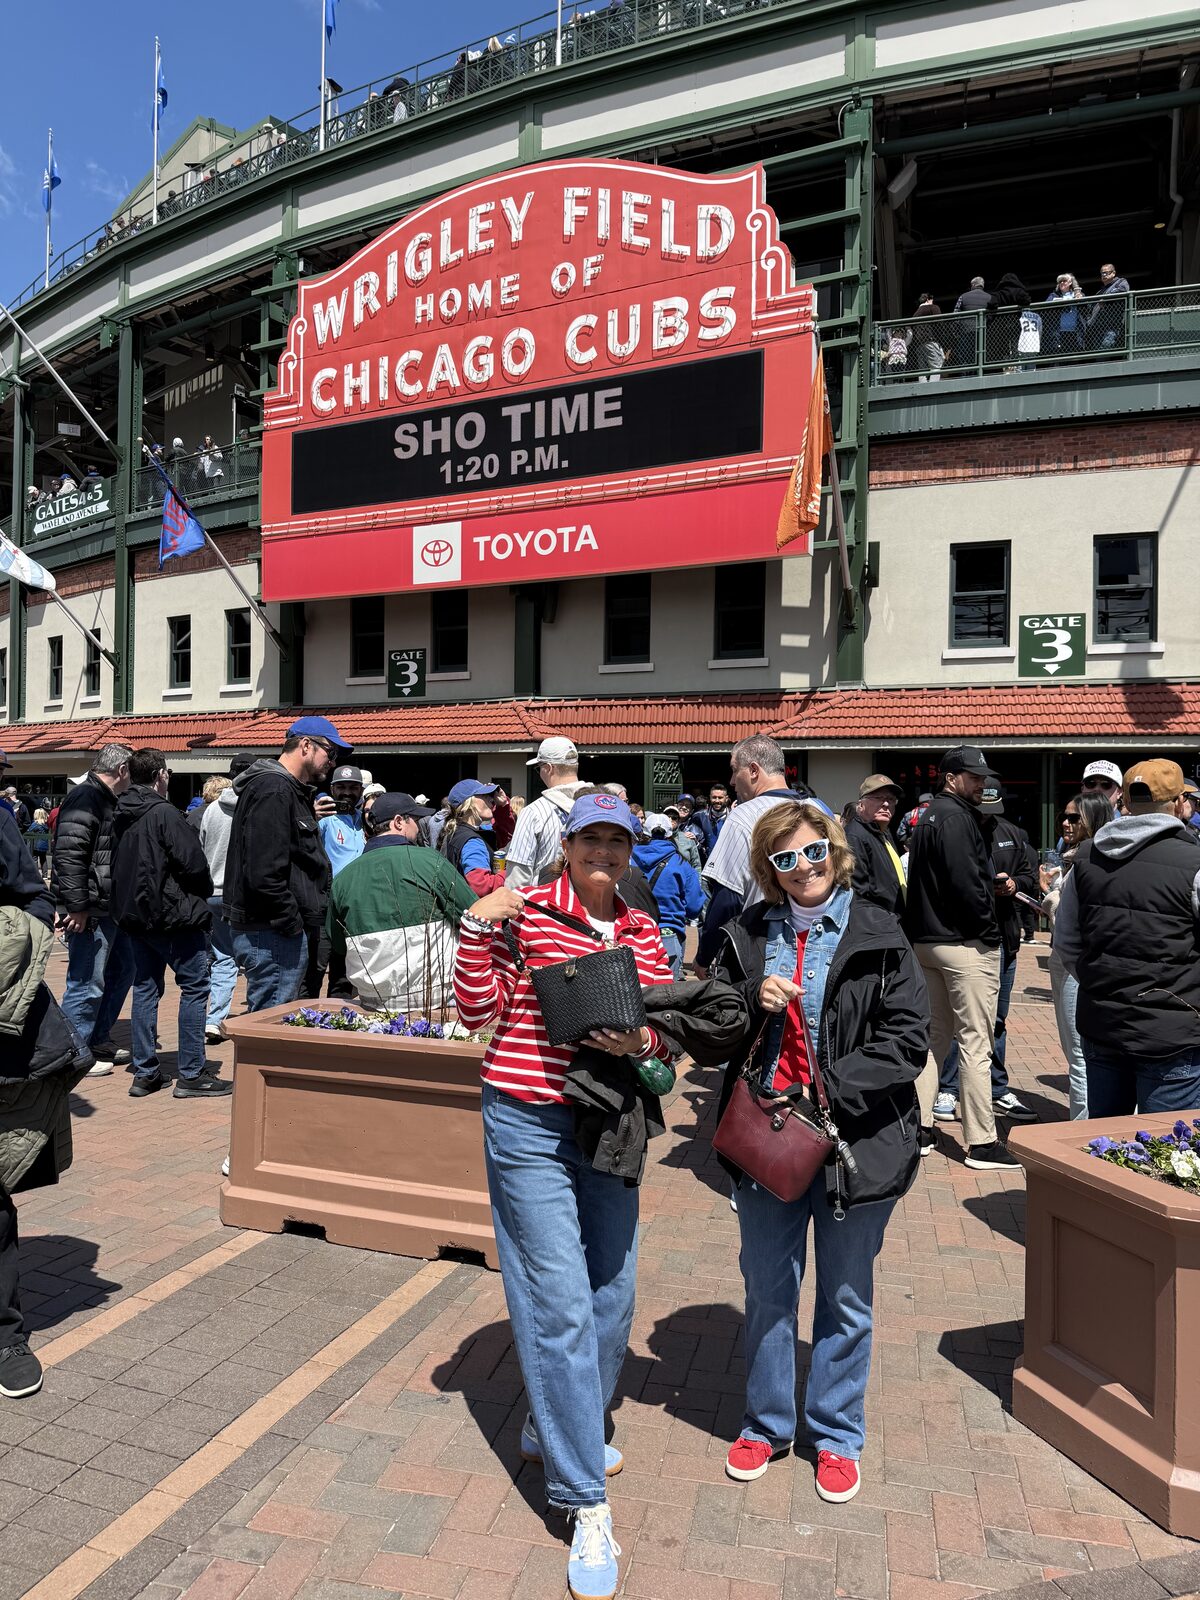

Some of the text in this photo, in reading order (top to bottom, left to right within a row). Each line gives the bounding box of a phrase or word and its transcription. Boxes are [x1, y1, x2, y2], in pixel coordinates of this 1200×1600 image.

[312, 187, 736, 345] WRIGLEY FIELD
[415, 254, 604, 324] HOME OF
[311, 286, 736, 412] CHICAGO CUBS
[393, 387, 623, 460] SHO TIME
[439, 444, 569, 484] 1:20 P.M.
[36, 493, 79, 520] GATES
[93, 483, 103, 501] 5
[42, 504, 99, 529] WAVELAND AVENUE
[473, 524, 599, 562] TOYOTA
[1023, 616, 1082, 629] GATE
[390, 650, 424, 661] GATE
[1031, 628, 1073, 663] 3
[394, 660, 419, 687] 3
[337, 828, 345, 845] 4
